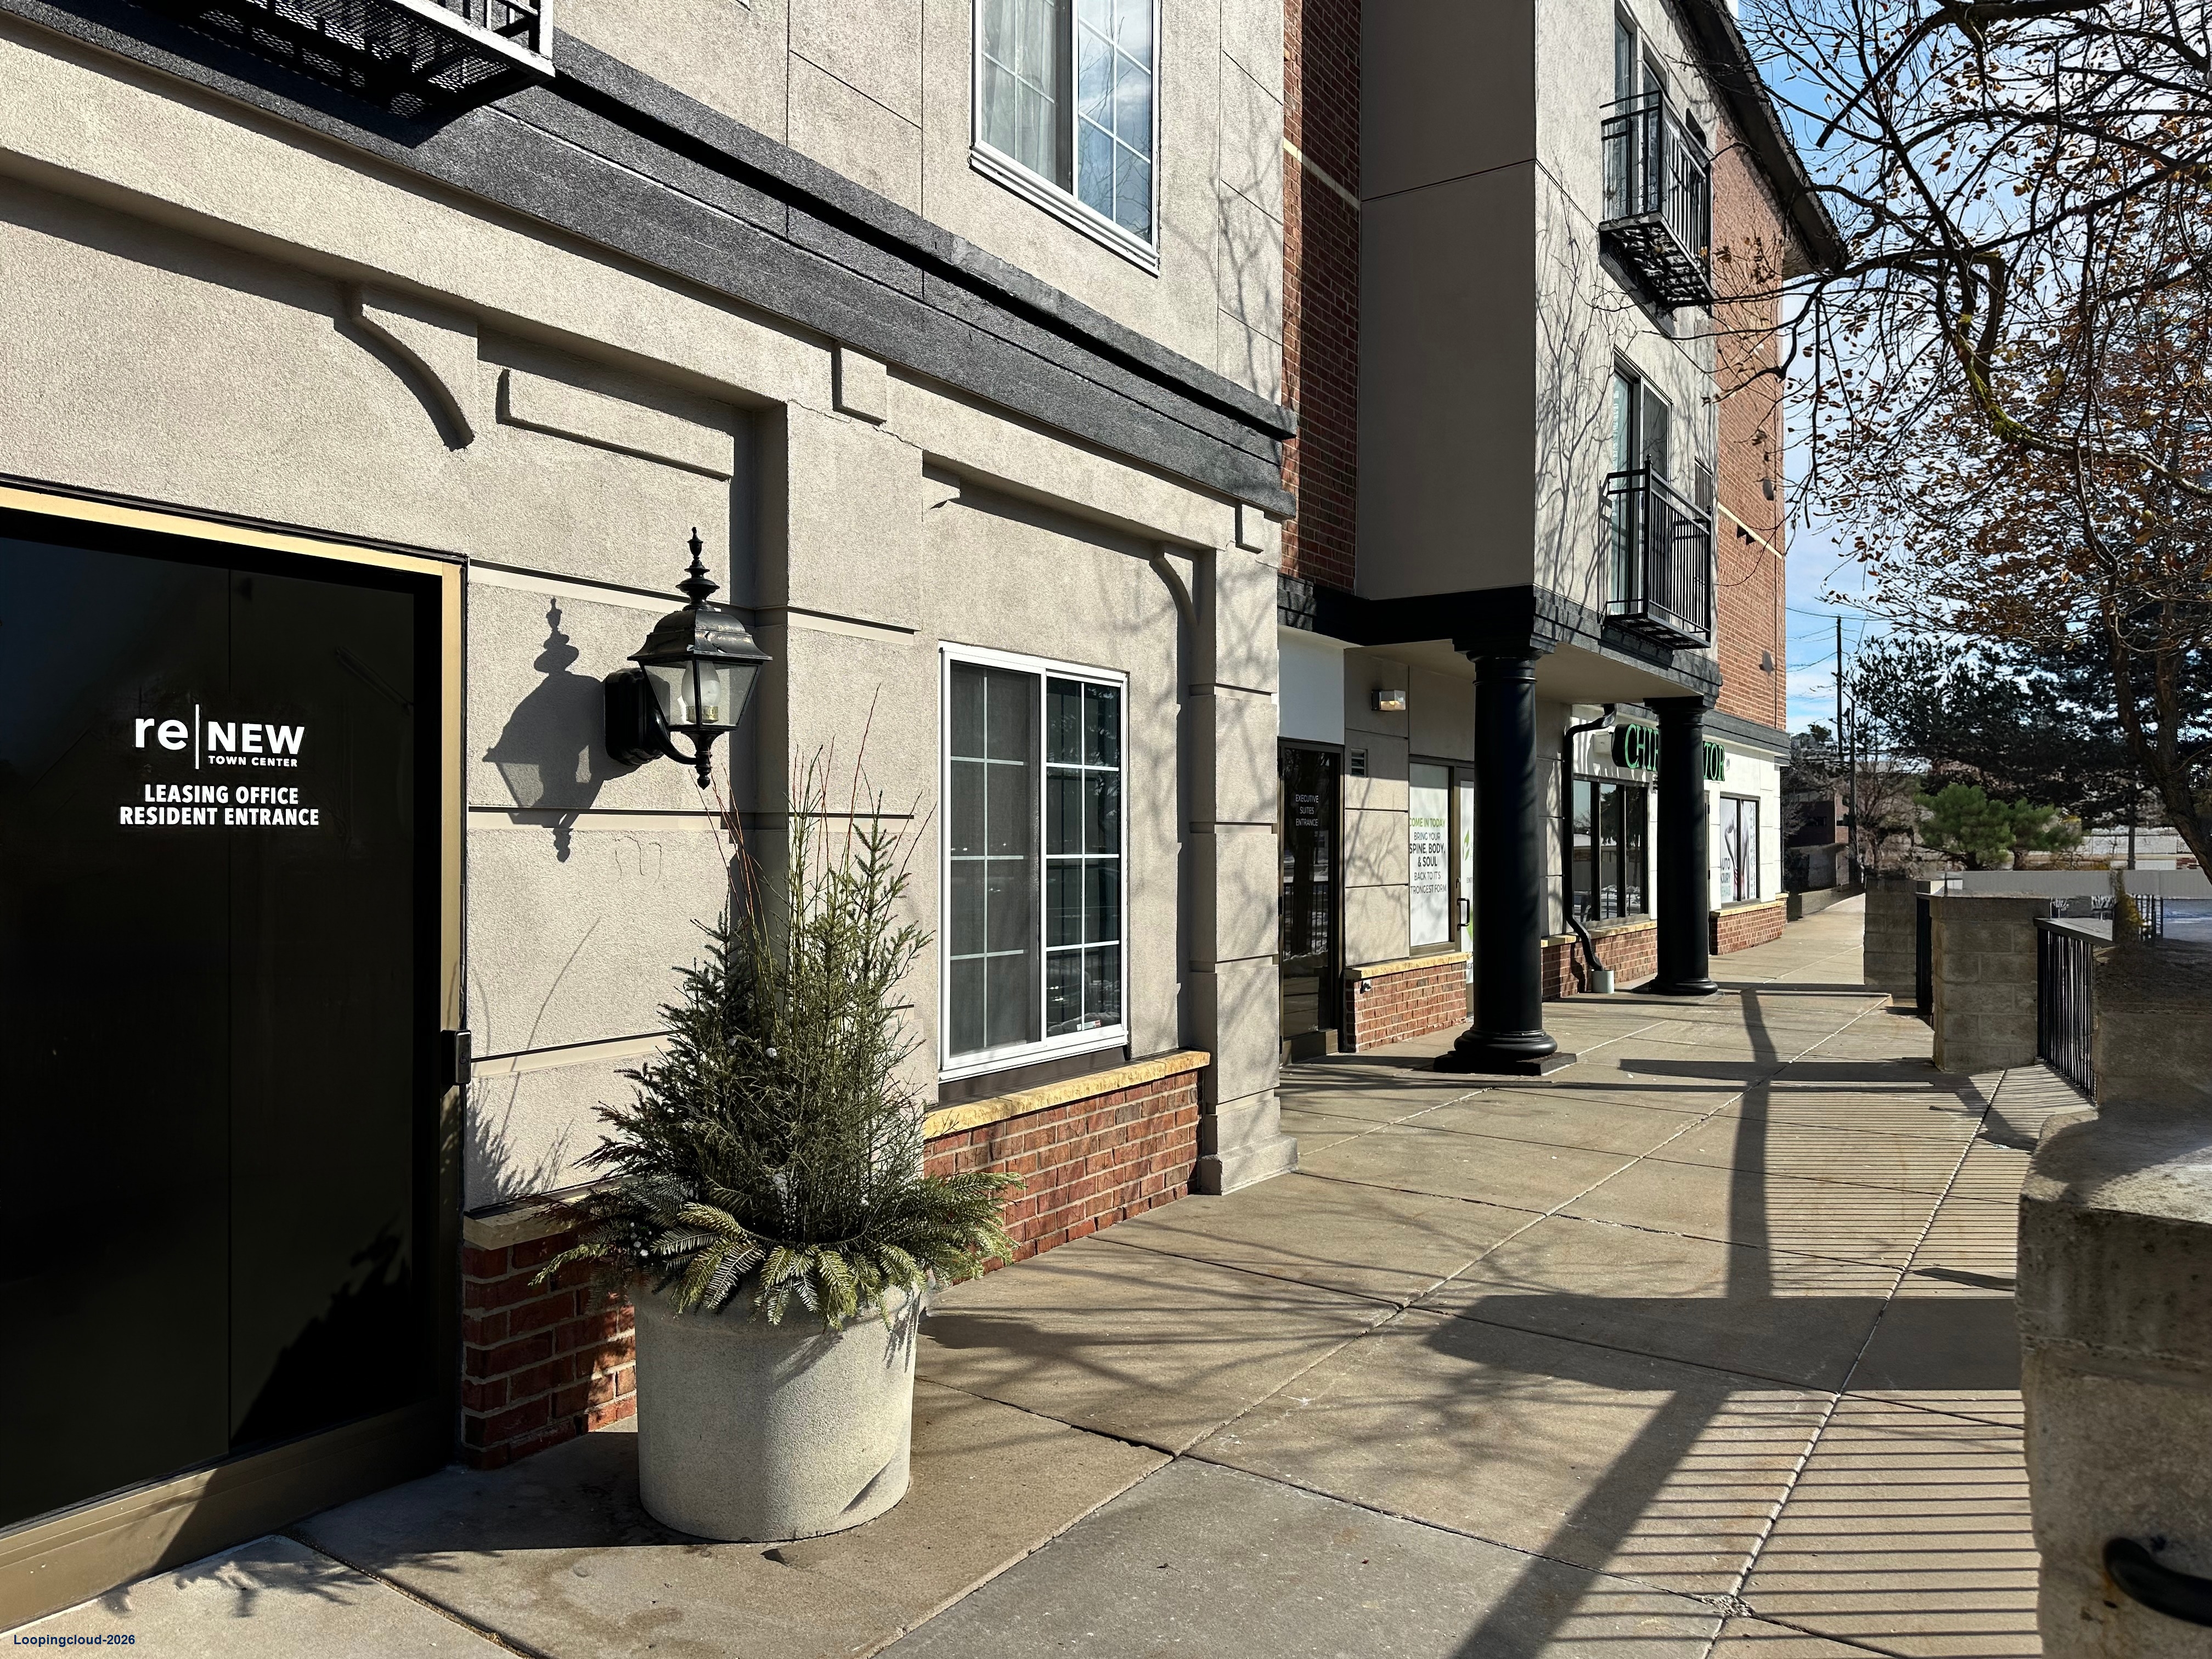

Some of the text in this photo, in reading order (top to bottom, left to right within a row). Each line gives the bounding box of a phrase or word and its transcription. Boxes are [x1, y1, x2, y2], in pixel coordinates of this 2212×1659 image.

[208, 755, 297, 767] TOWN CENTER
[145, 784, 300, 805] LEASING OFFICE
[1295, 794, 1319, 803] EXECUTIVE
[1300, 806, 1314, 815] SUITES
[120, 806, 319, 826] RESIDENT ENTRANCE
[1296, 818, 1318, 827] ENTRANCE
[1424, 817, 1429, 827] IN
[1430, 818, 1446, 828] TODAY
[1414, 832, 1441, 840] BRING YOUR
[1418, 856, 1437, 867] & SOUL
[1414, 872, 1426, 881] BACK
[1427, 871, 1433, 880] TO
[1410, 884, 1447, 894] TRONGEST FORM
